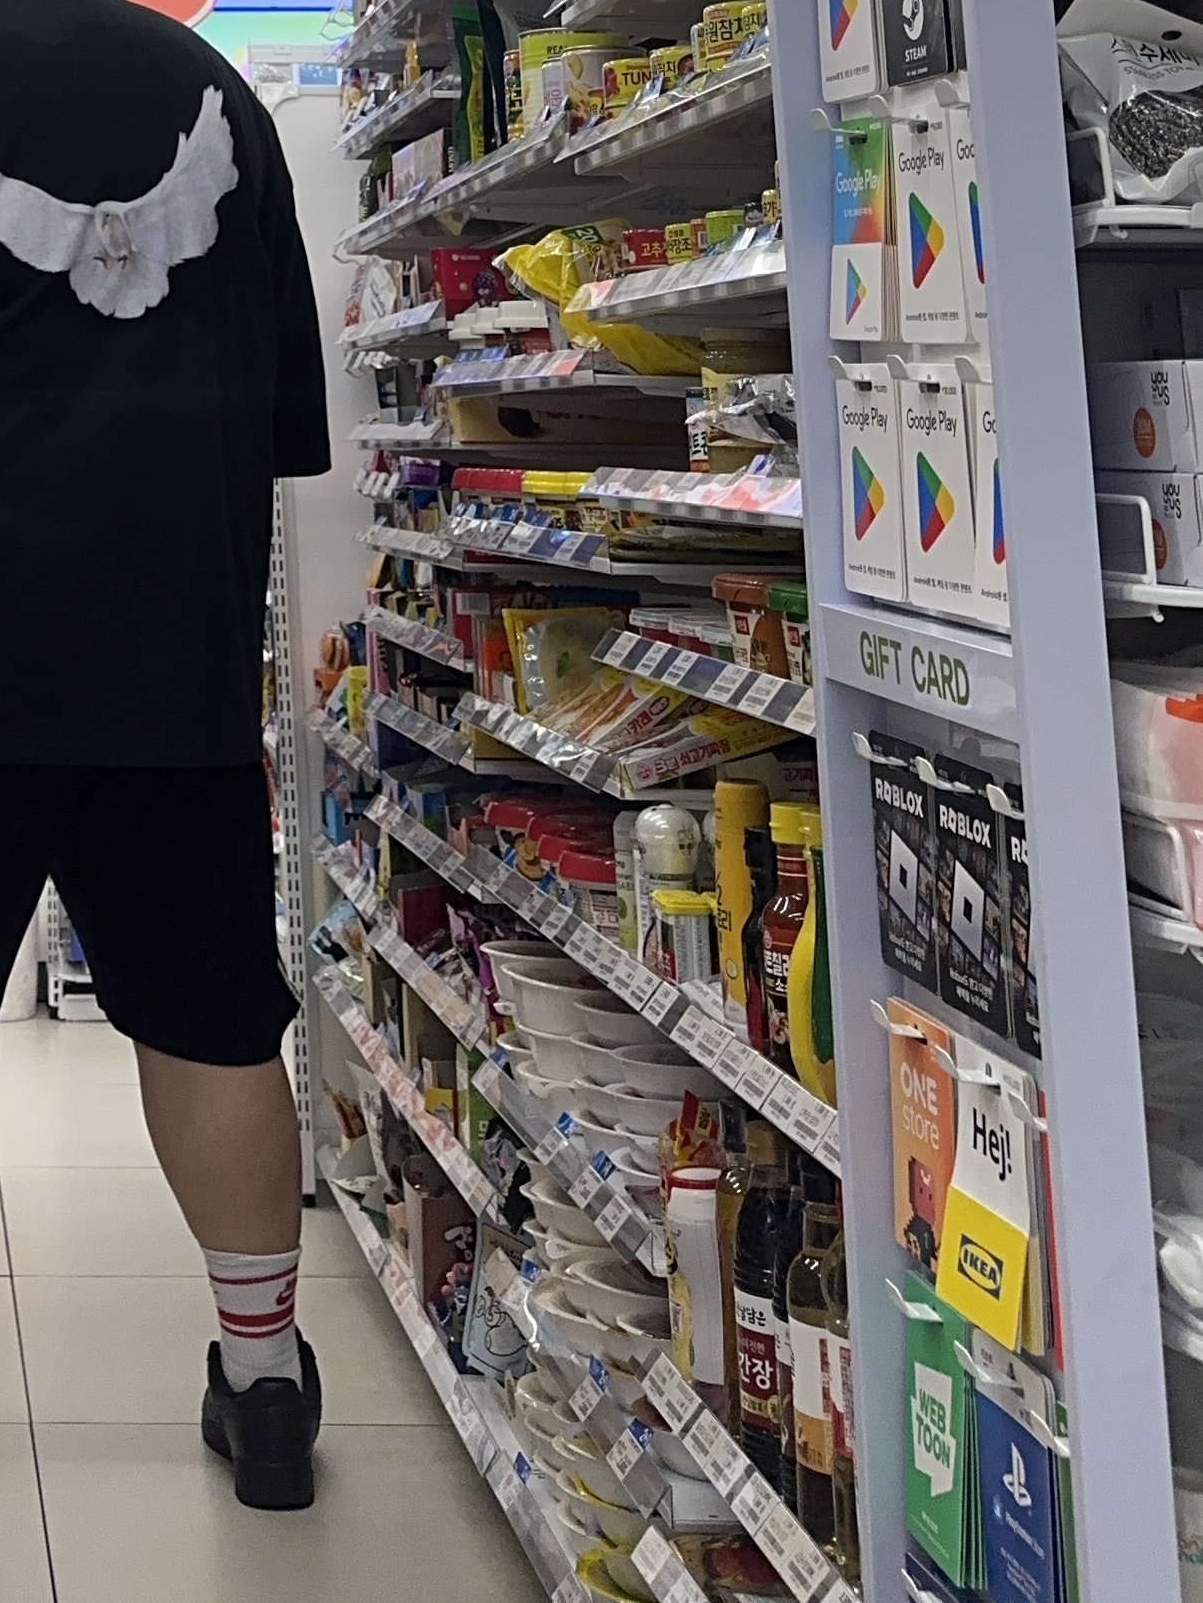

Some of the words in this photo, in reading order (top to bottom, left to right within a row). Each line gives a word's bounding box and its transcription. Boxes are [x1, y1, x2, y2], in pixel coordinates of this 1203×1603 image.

[905, 45, 927, 62] STEAM
[836, 170, 864, 196] Google
[864, 167, 881, 194] Play
[899, 152, 926, 175] Google
[928, 148, 945, 171] Play
[842, 405, 869, 431] Google
[871, 406, 888, 433] Play
[906, 409, 937, 436] Google
[939, 410, 957, 437] Play
[859, 630, 903, 686] GIFT
[910, 645, 971, 707] CARD
[875, 777, 925, 819] ROBLOX
[939, 804, 992, 849] ROBLOX
[900, 1061, 938, 1116] ONE
[902, 1104, 940, 1150] store
[972, 1107, 1012, 1182] Hej!
[963, 1248, 999, 1287] IKEA
[919, 1387, 948, 1435] WEB
[915, 1411, 951, 1470] TOON
